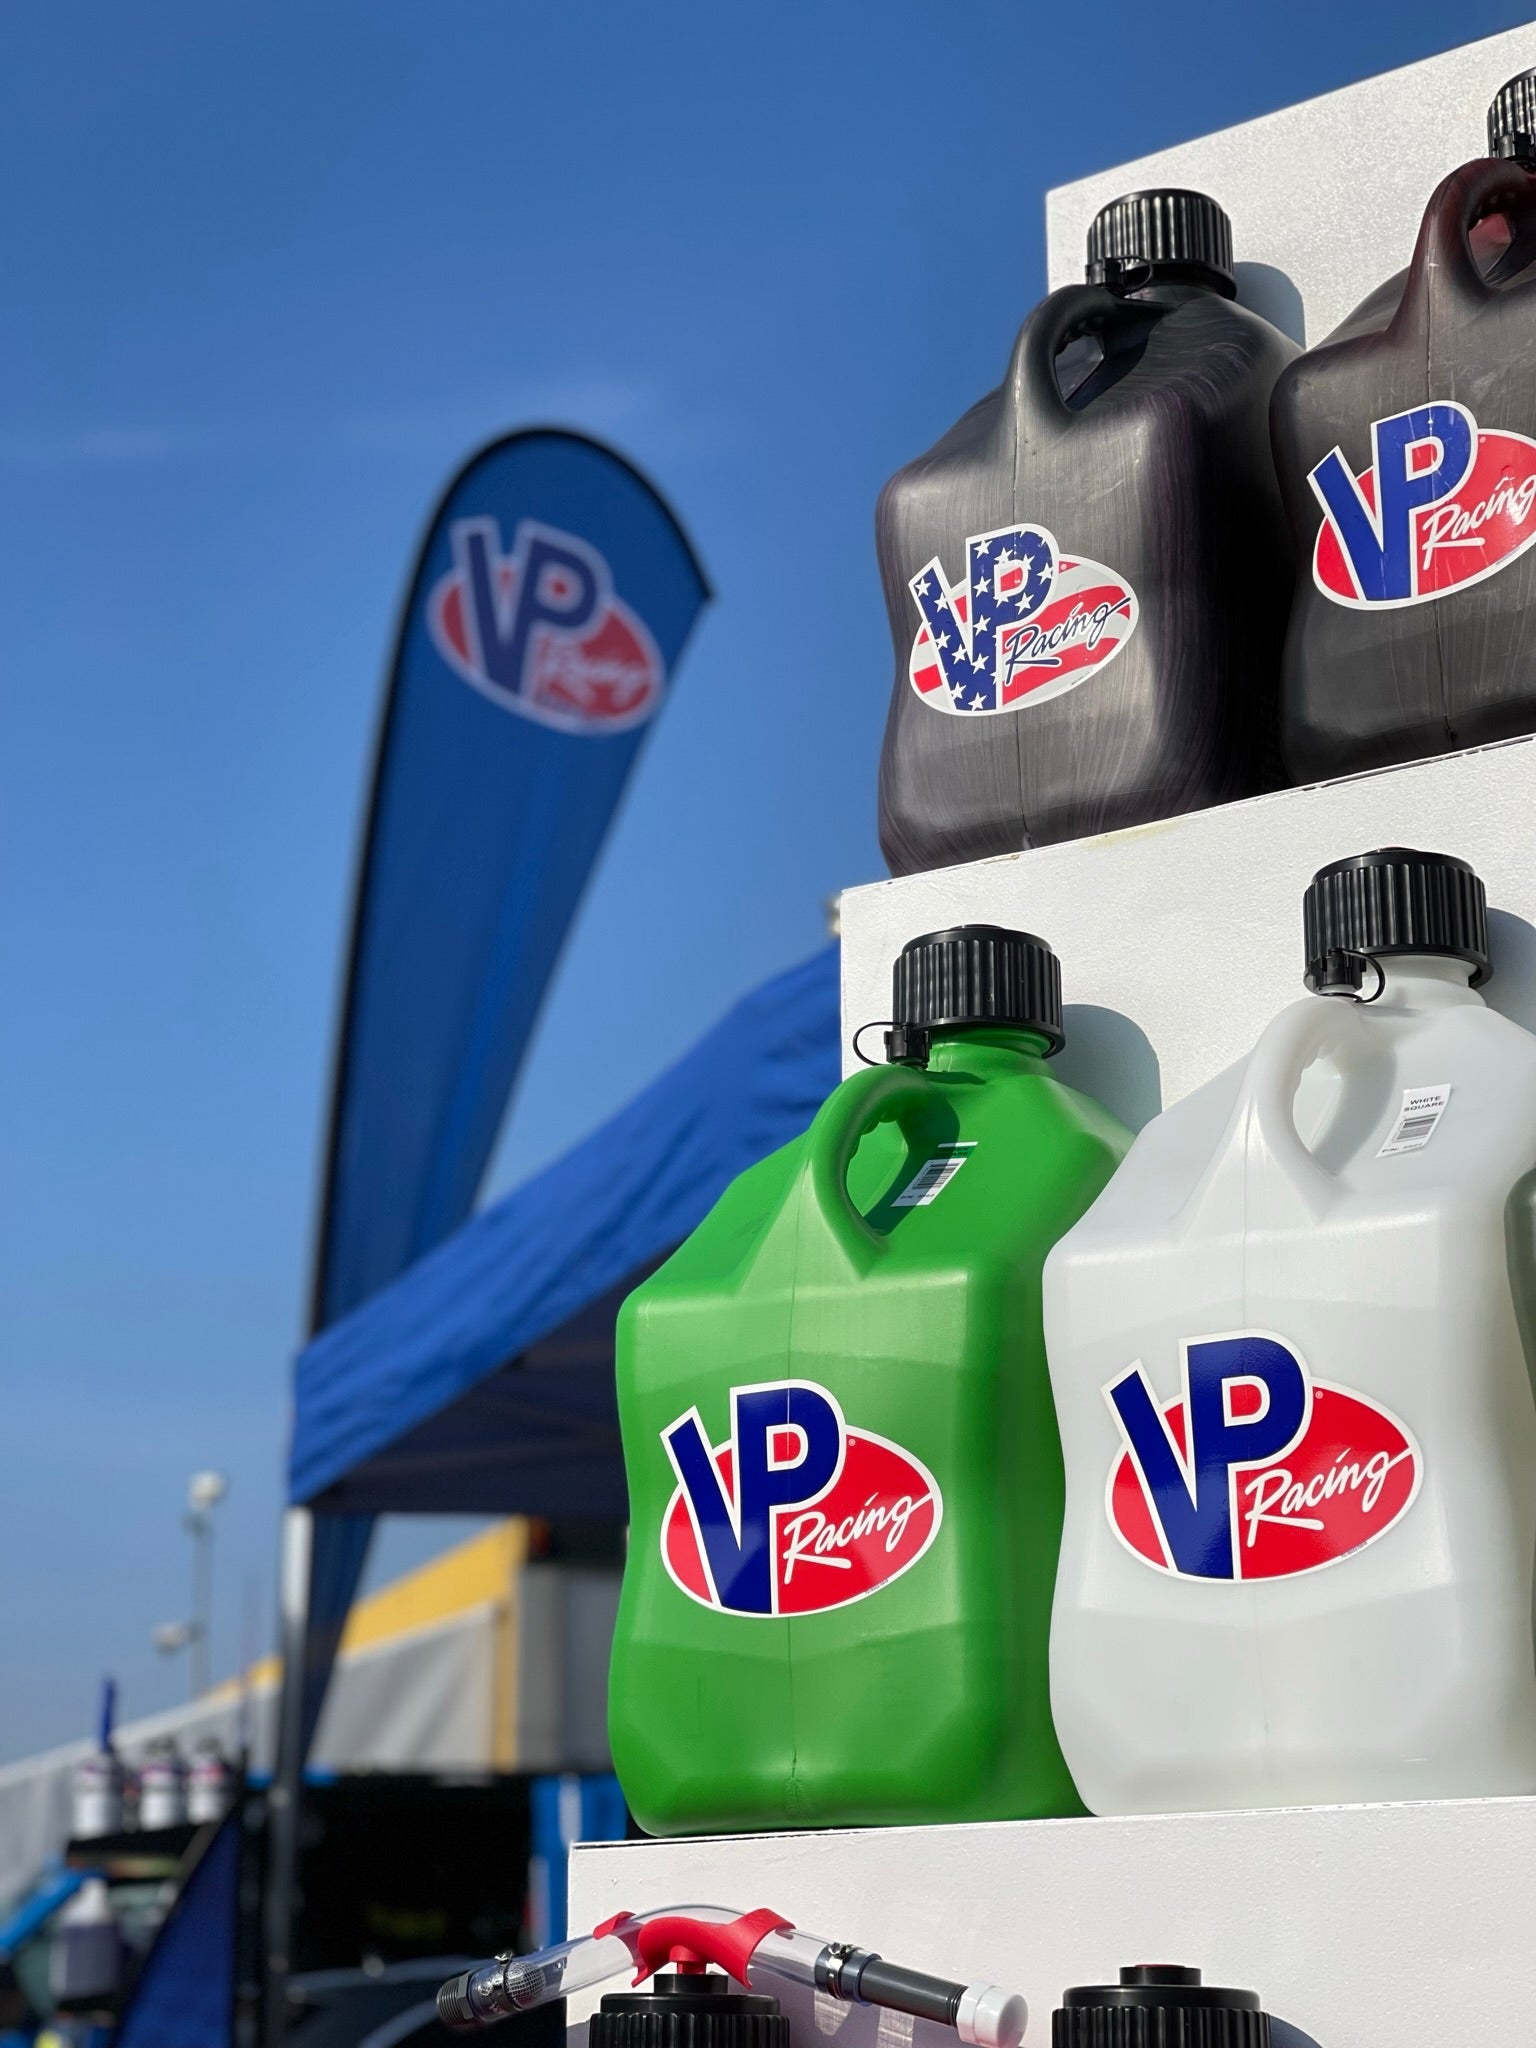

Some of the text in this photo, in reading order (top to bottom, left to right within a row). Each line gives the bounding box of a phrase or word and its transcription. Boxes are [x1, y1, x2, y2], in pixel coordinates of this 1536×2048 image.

[1312, 404, 1472, 601] VP
[1422, 474, 1536, 571] Racing
[464, 528, 600, 698] VP
[913, 530, 1054, 711] VP
[1004, 602, 1131, 685] Racing
[1403, 1101, 1445, 1112] SQUARE
[1410, 1095, 1441, 1106] WHITE
[667, 1386, 841, 1615] VP
[1109, 1336, 1306, 1580] VP
[1245, 1447, 1413, 1548] Racing
[783, 1492, 932, 1585] Racing
